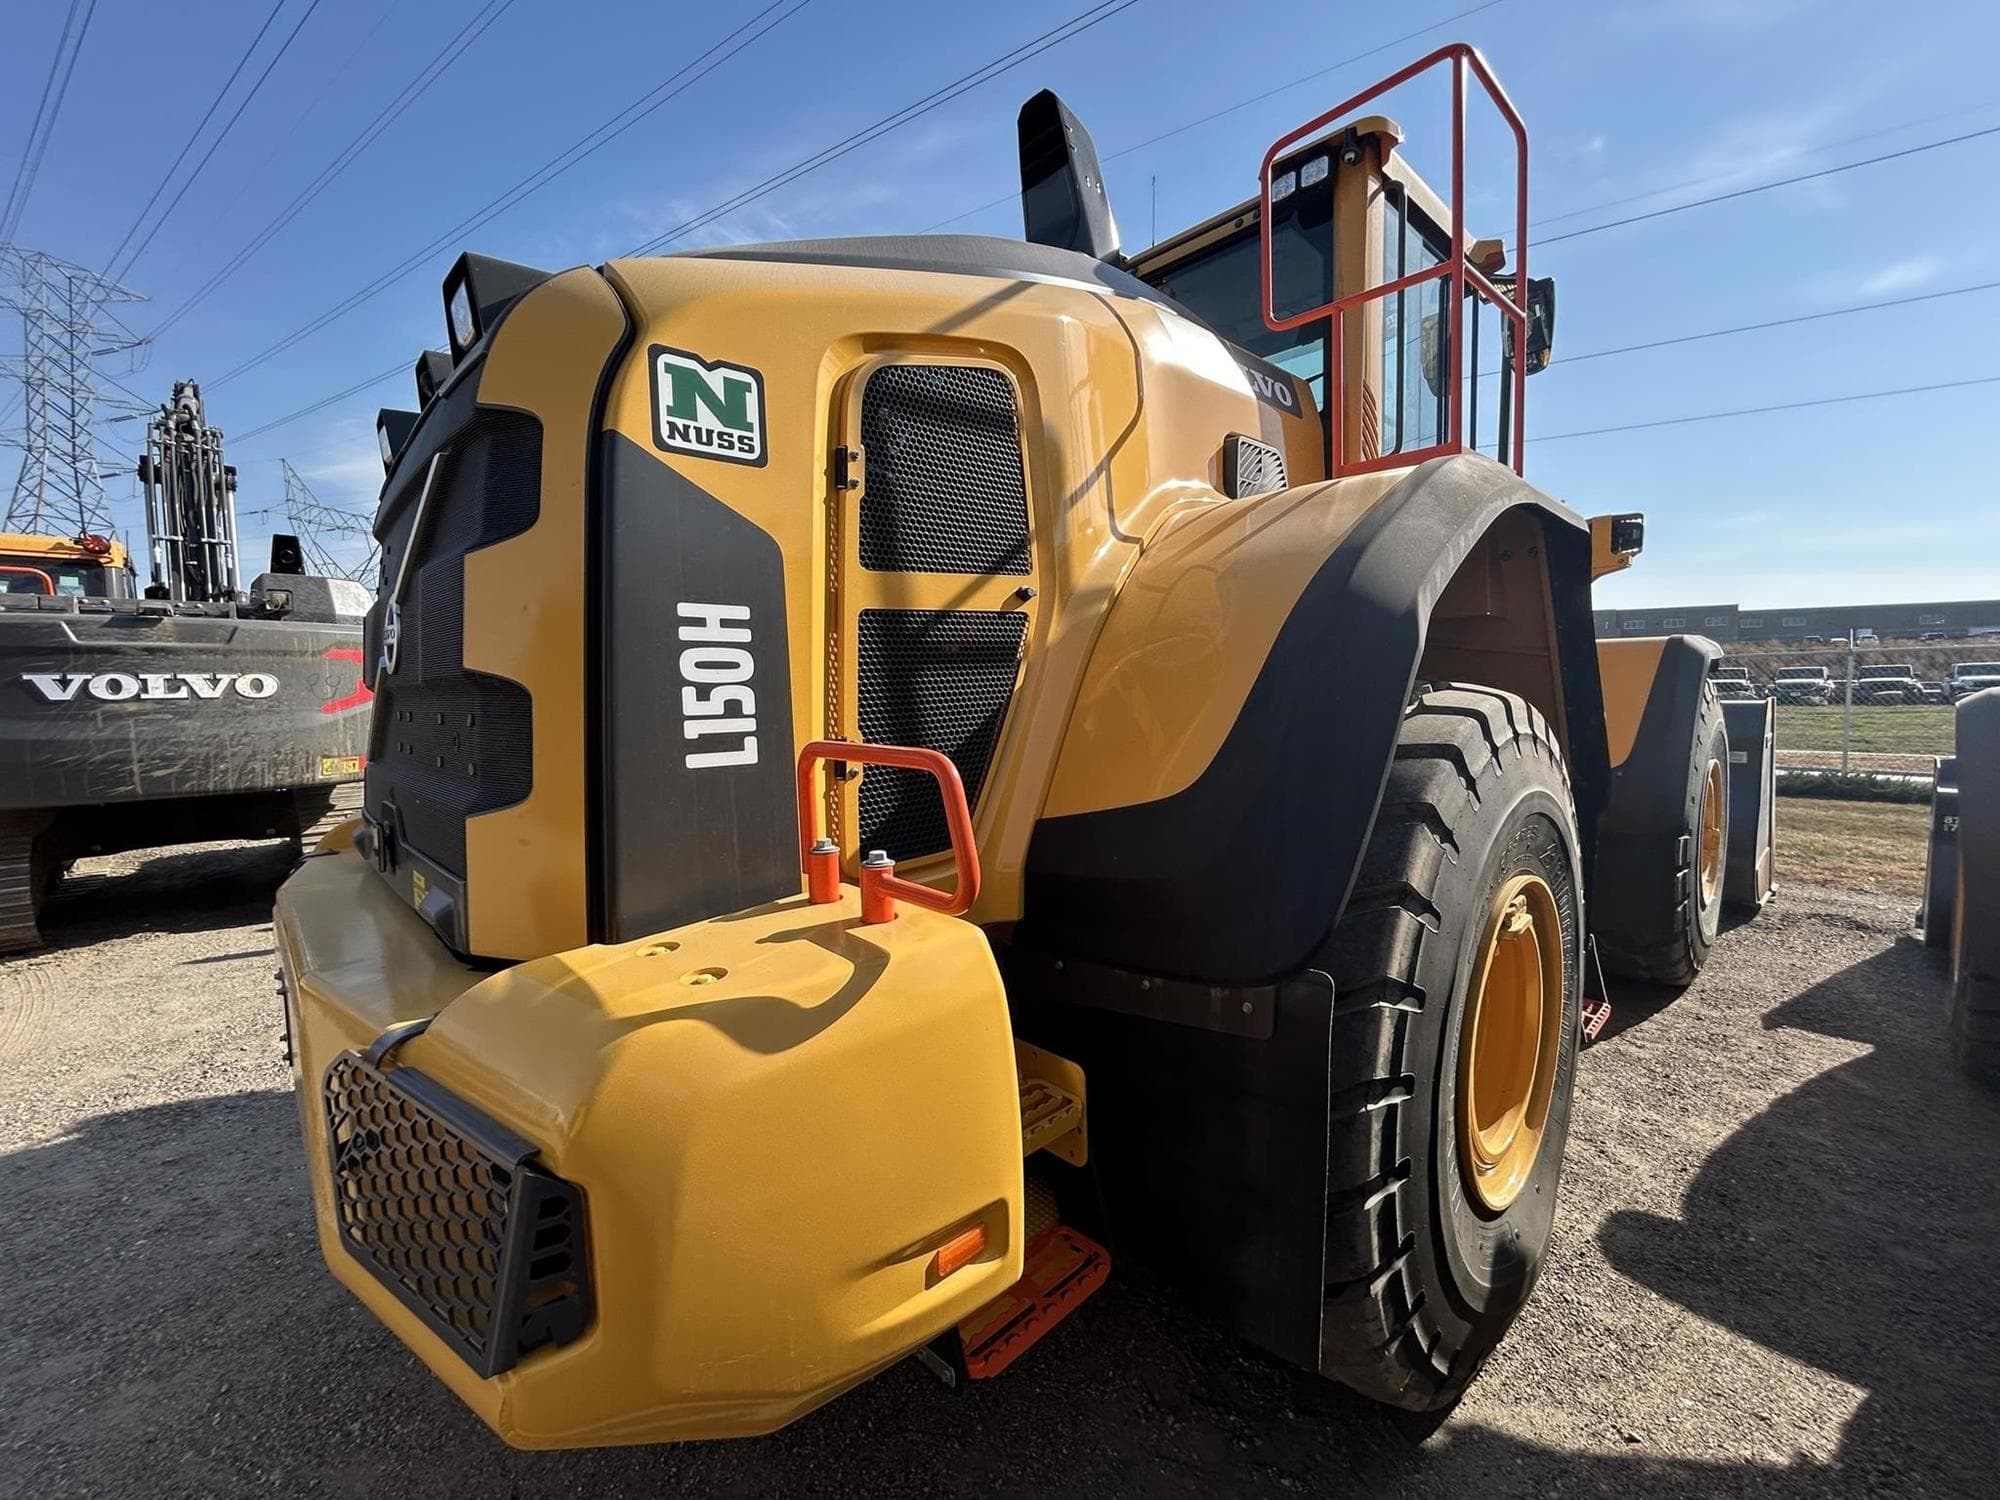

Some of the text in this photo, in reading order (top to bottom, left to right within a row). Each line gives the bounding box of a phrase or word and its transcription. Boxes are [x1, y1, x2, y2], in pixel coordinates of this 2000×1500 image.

[663, 361, 754, 433] N
[666, 420, 755, 454] NUSS
[22, 672, 279, 701] VOLVO
[676, 602, 759, 769] L150H
